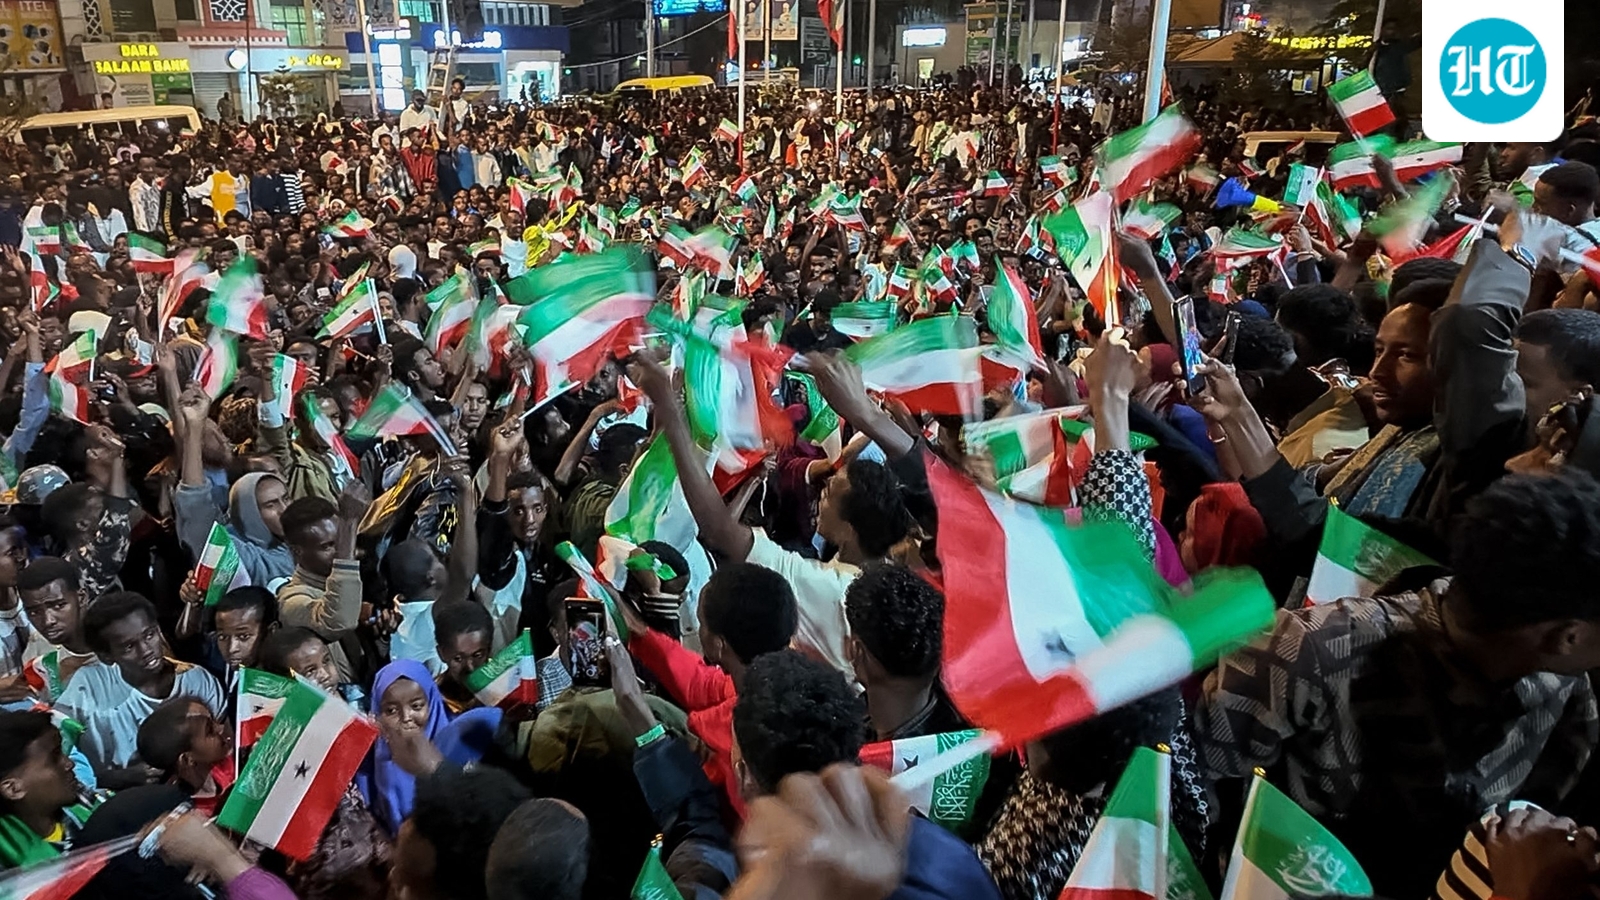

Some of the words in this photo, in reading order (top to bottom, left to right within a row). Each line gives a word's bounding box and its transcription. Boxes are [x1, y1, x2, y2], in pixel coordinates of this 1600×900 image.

[121, 44, 159, 57] DARA
[95, 60, 152, 73] SALAAM
[153, 59, 190, 72] BANK
